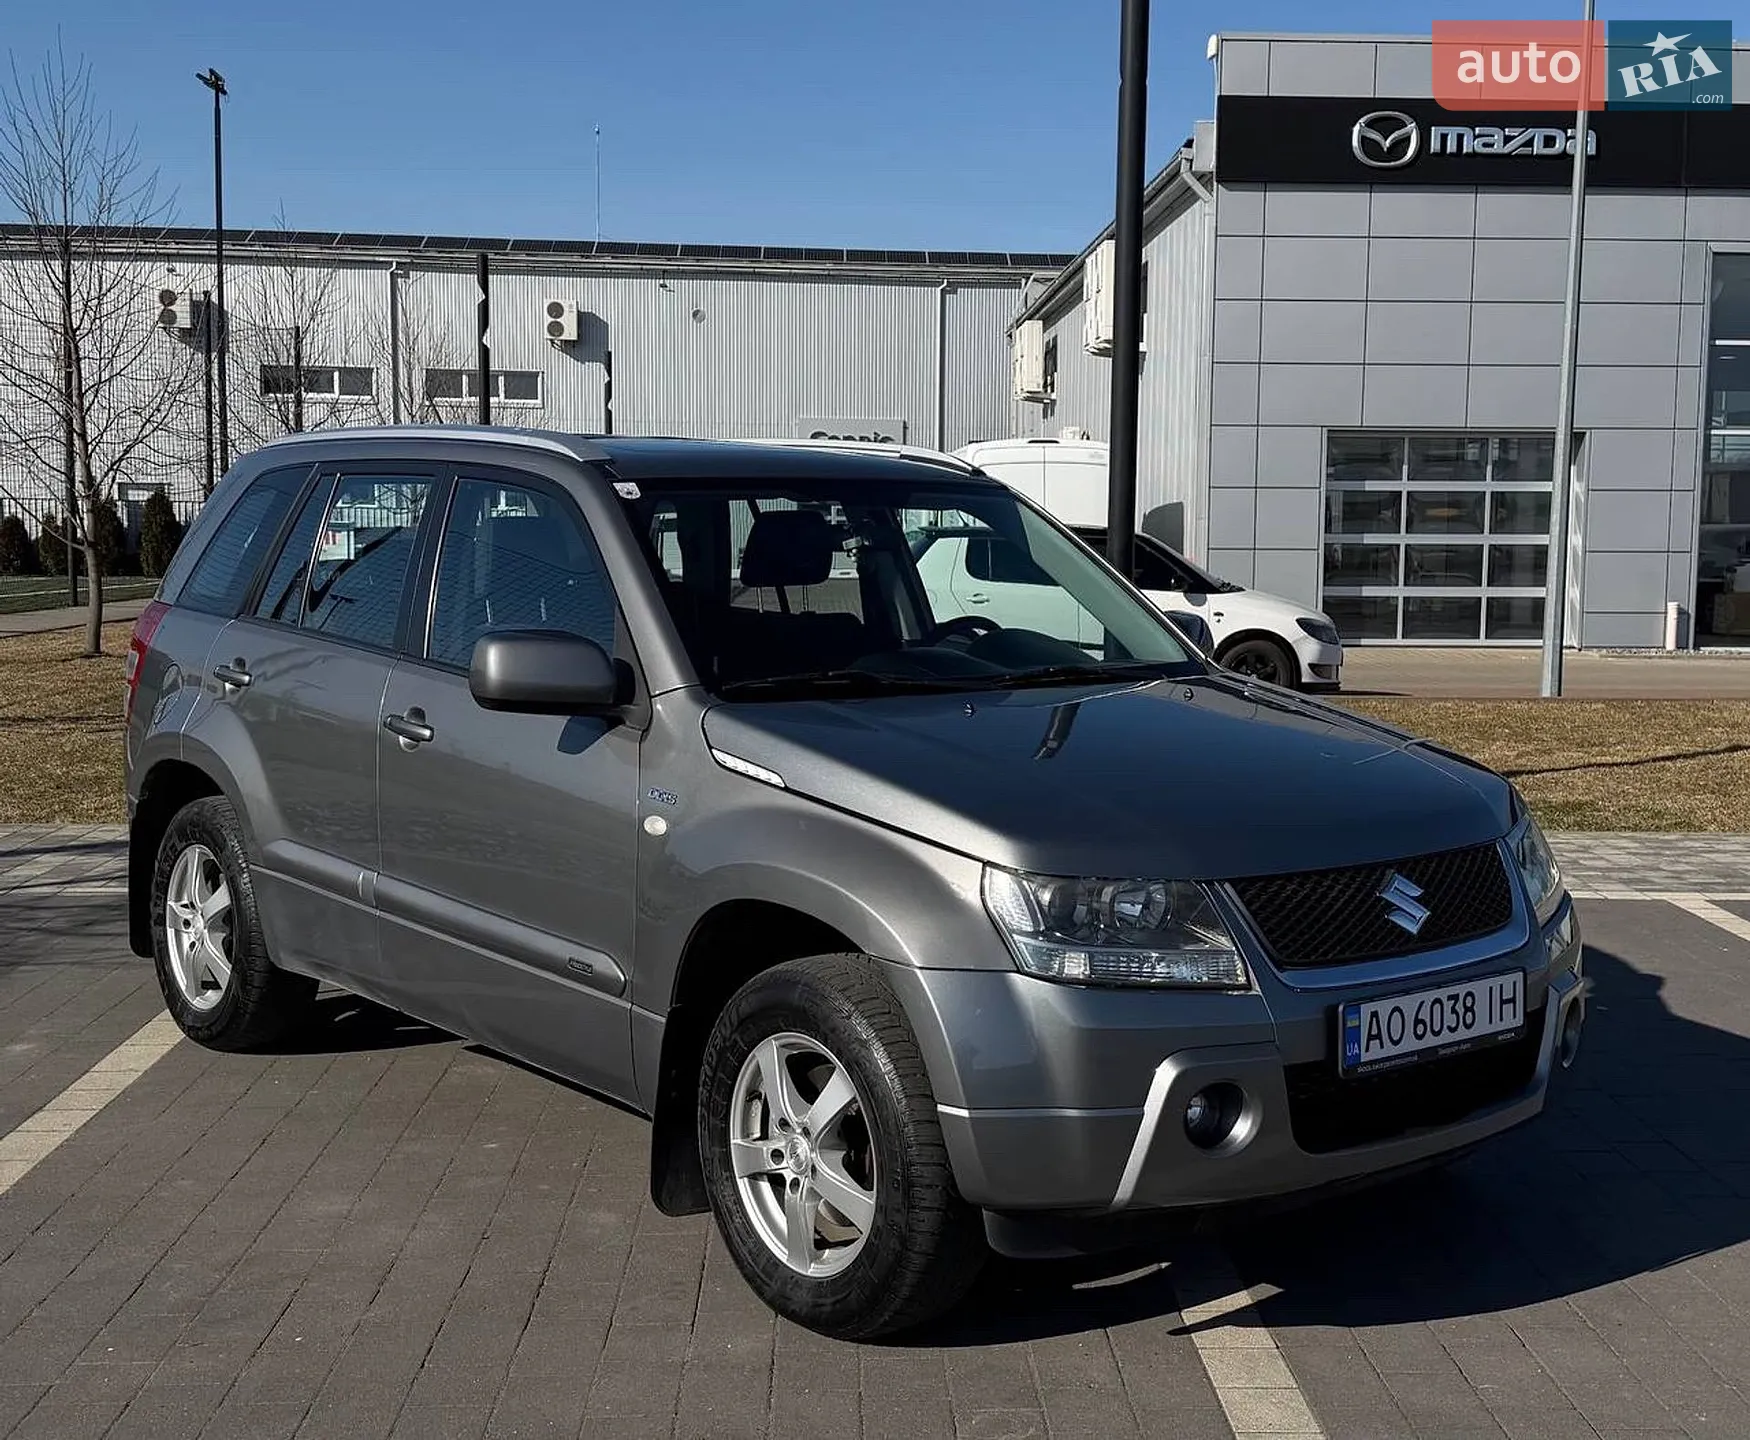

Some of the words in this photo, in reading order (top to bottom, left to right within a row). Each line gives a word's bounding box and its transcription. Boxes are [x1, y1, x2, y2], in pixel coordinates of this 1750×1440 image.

[1430, 125, 1597, 156] mazda
[1365, 1005, 1405, 1053] AO
[1413, 990, 1476, 1041] 6038
[1489, 981, 1517, 1025] IH
[1346, 1042, 1360, 1057] UA
